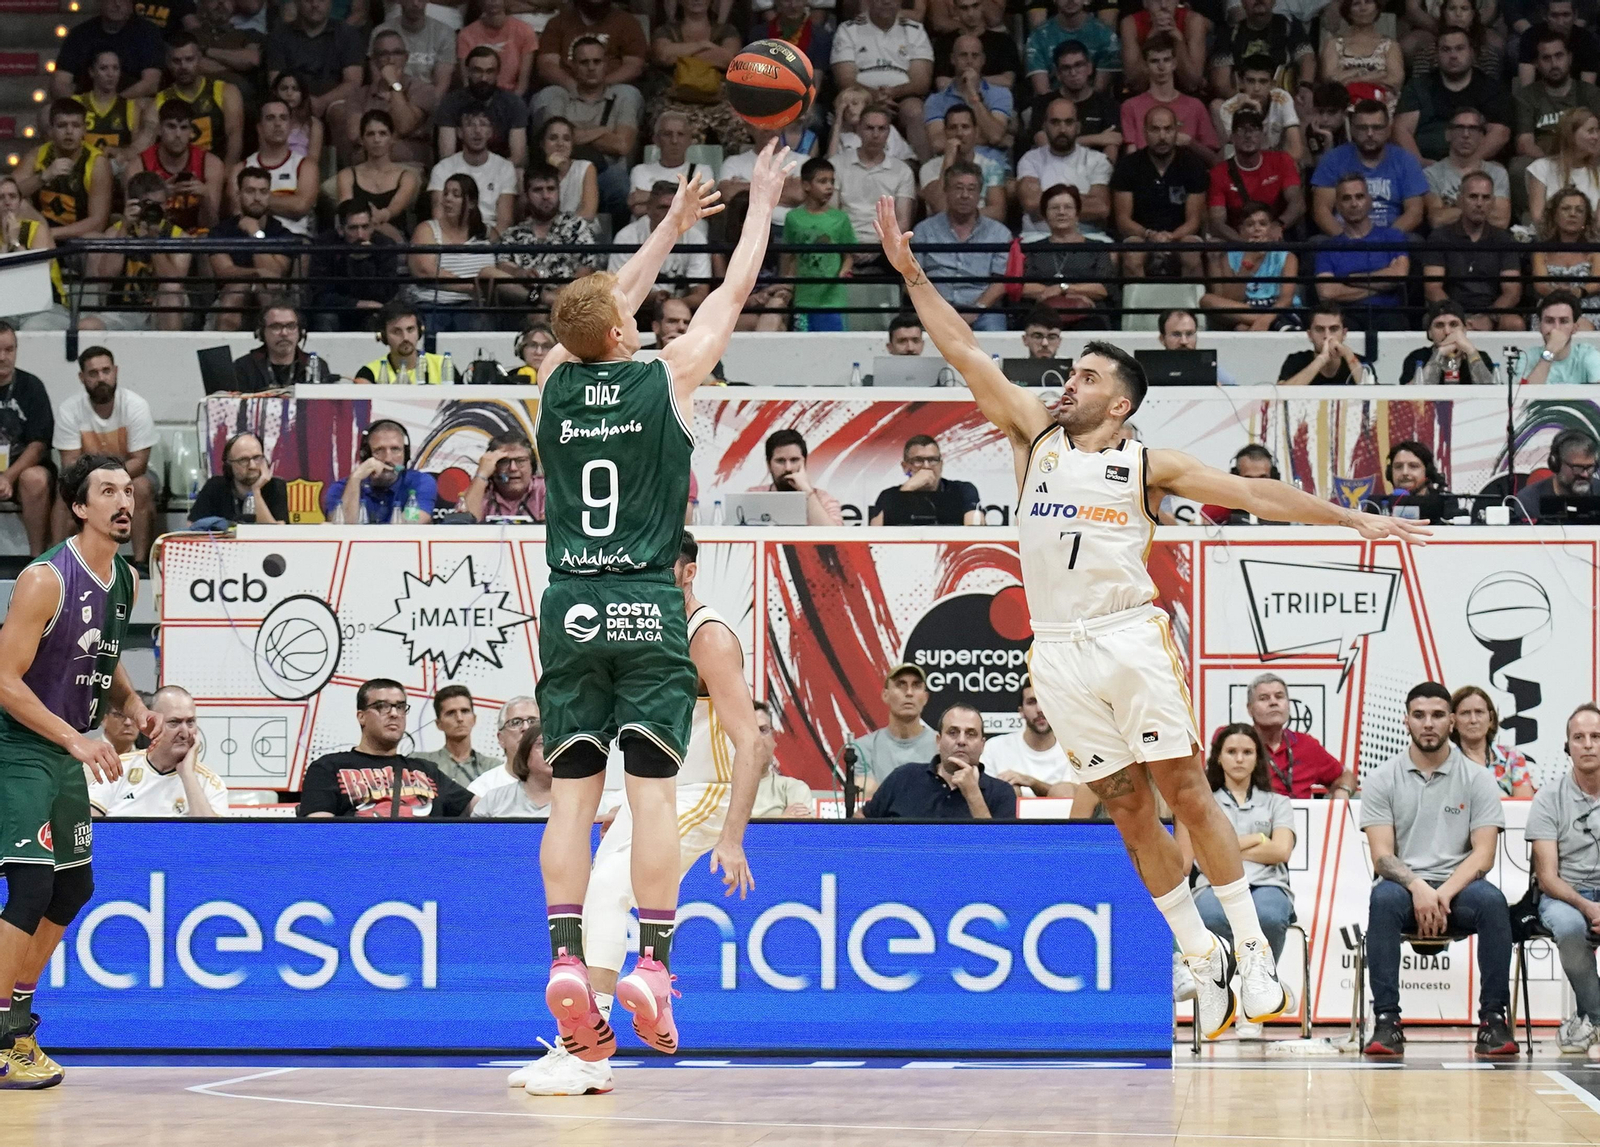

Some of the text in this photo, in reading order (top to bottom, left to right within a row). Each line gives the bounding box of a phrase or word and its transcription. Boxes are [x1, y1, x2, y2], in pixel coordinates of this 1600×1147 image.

[585, 382, 621, 406] DÍAZ
[582, 459, 619, 537] 9
[1030, 502, 1129, 526] AUTOHERO
[560, 546, 635, 568] Andalucía
[1060, 531, 1082, 570] 7
[190, 573, 267, 603] acb
[606, 602, 662, 617] COSTA
[1264, 592, 1377, 618] ¡TRIIPLE!
[412, 608, 493, 631] ¡MATE!
[606, 618, 663, 629] DEL SOL
[606, 628, 663, 642] MÁLAGA
[50, 871, 438, 990] desa
